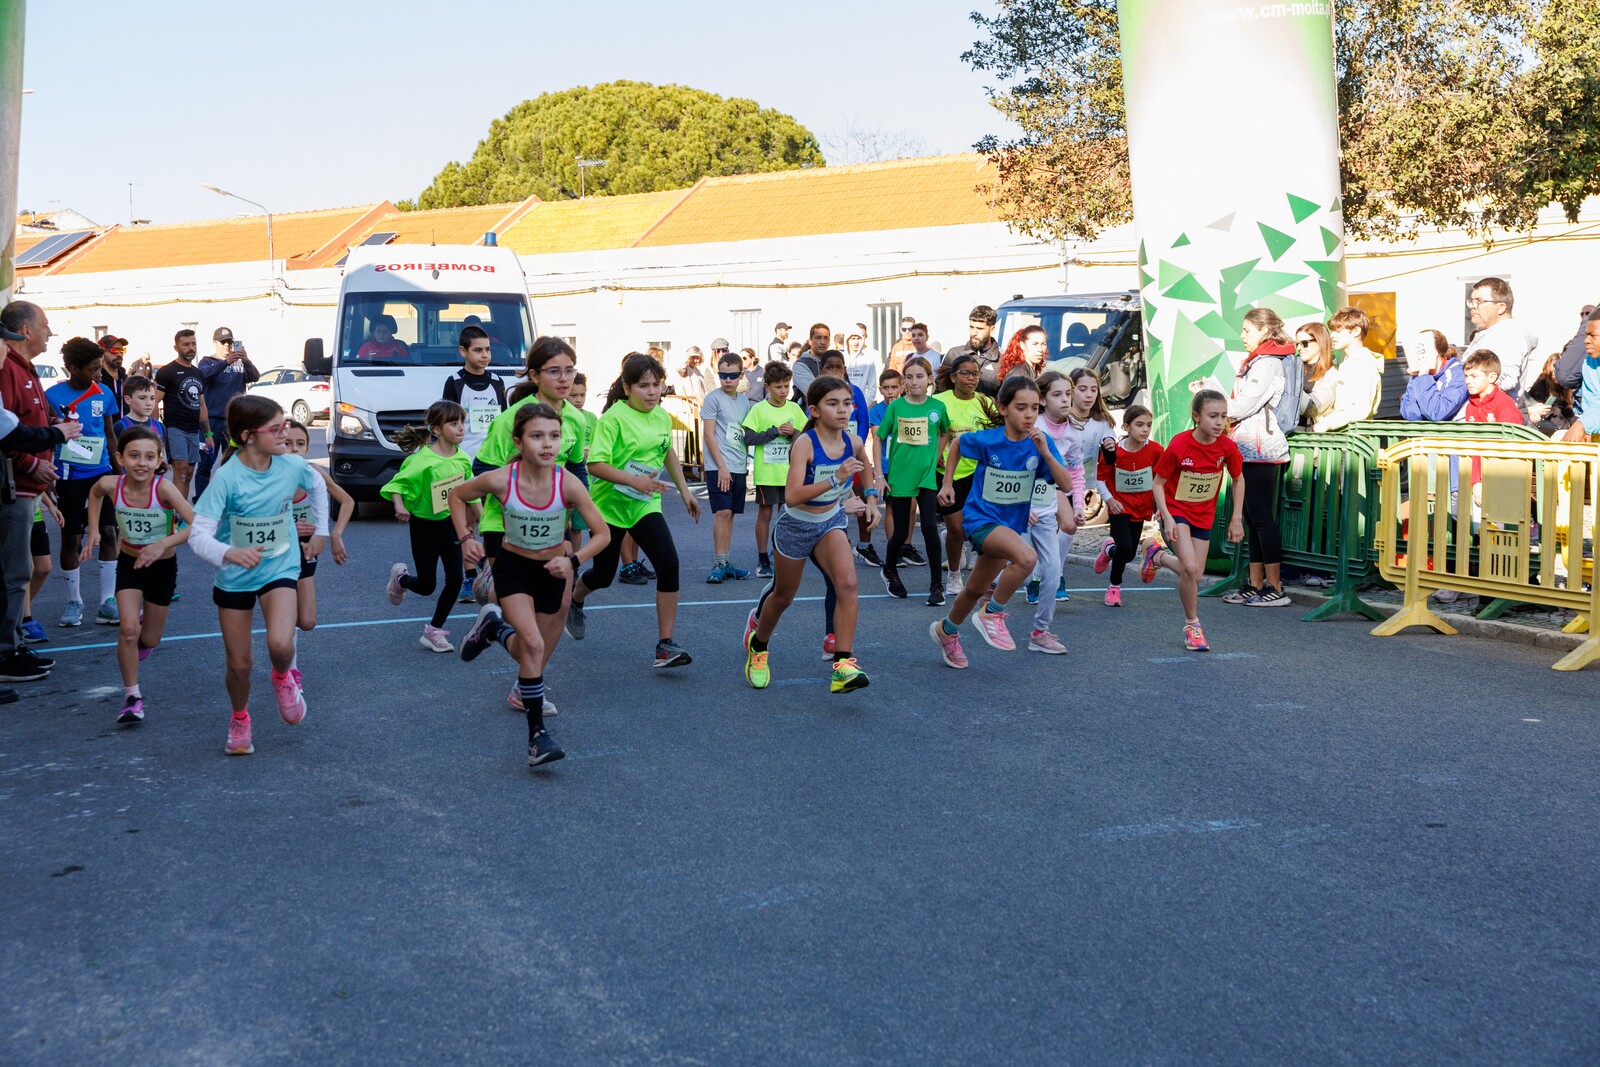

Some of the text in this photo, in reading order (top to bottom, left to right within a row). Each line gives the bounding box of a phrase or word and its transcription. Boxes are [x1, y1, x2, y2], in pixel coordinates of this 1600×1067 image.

[478, 414, 495, 423] 428
[904, 426, 922, 436] 805
[772, 447, 788, 455] 377
[1124, 477, 1144, 486] 425
[995, 481, 1021, 493] 200
[1189, 483, 1211, 494] 782
[125, 519, 152, 533] 133
[256, 518, 284, 527] 2024/2025
[519, 524, 550, 538] 152
[245, 529, 276, 544] 134
